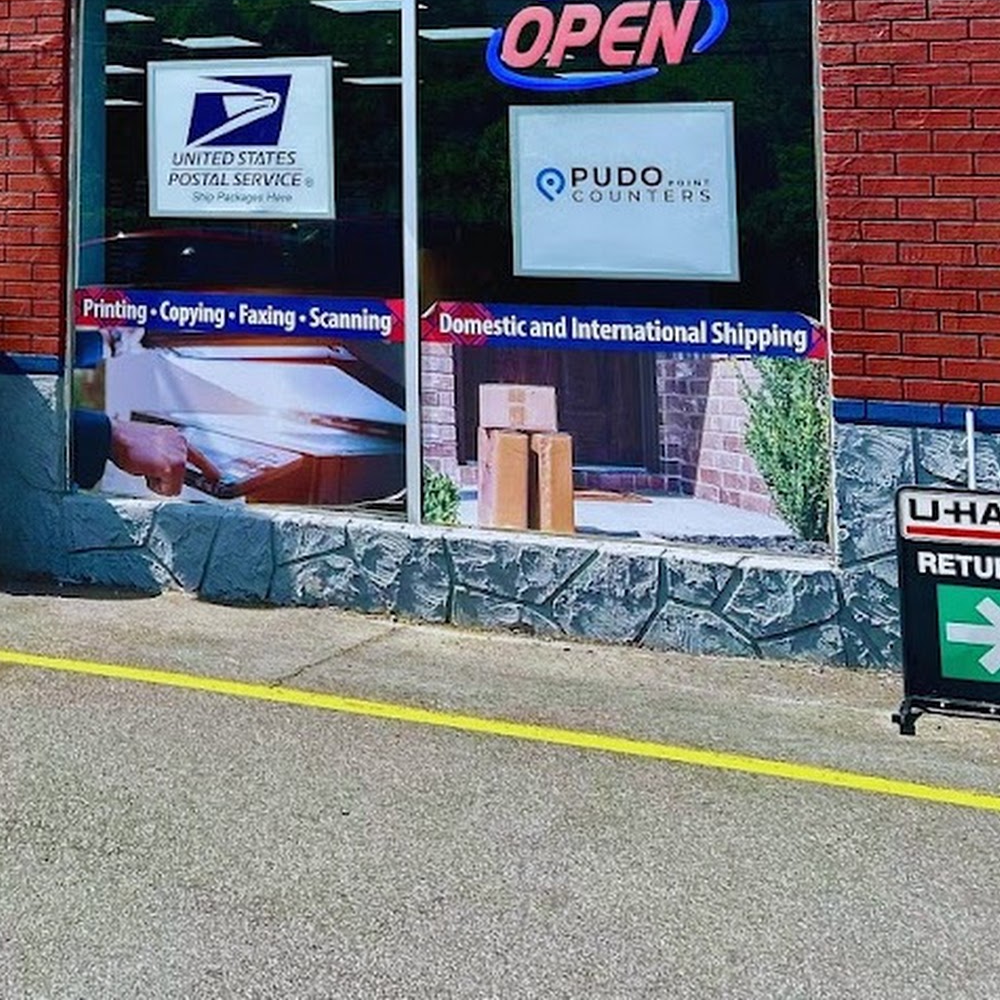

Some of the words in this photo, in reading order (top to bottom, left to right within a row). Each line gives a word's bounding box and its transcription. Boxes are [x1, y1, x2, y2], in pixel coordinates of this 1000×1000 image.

[172, 151, 235, 166] UNITED
[237, 151, 297, 166] STATES
[168, 172, 231, 187] POSTAL
[232, 172, 302, 187] SERVICE
[571, 166, 663, 188] PUDO
[668, 178, 711, 187] POINT
[193, 191, 215, 204] Ship
[217, 192, 265, 205] Packages
[266, 192, 293, 202] Here
[571, 189, 712, 203] COUNTERS
[83, 298, 148, 325] Printing
[159, 300, 226, 329] Copying
[239, 303, 297, 332] Faxing
[309, 307, 393, 337] Scanning
[438, 312, 528, 337] Domestic
[529, 316, 567, 339] and
[571, 316, 708, 345] International
[710, 321, 809, 353] Shipping
[917, 551, 1000, 580] RETU
